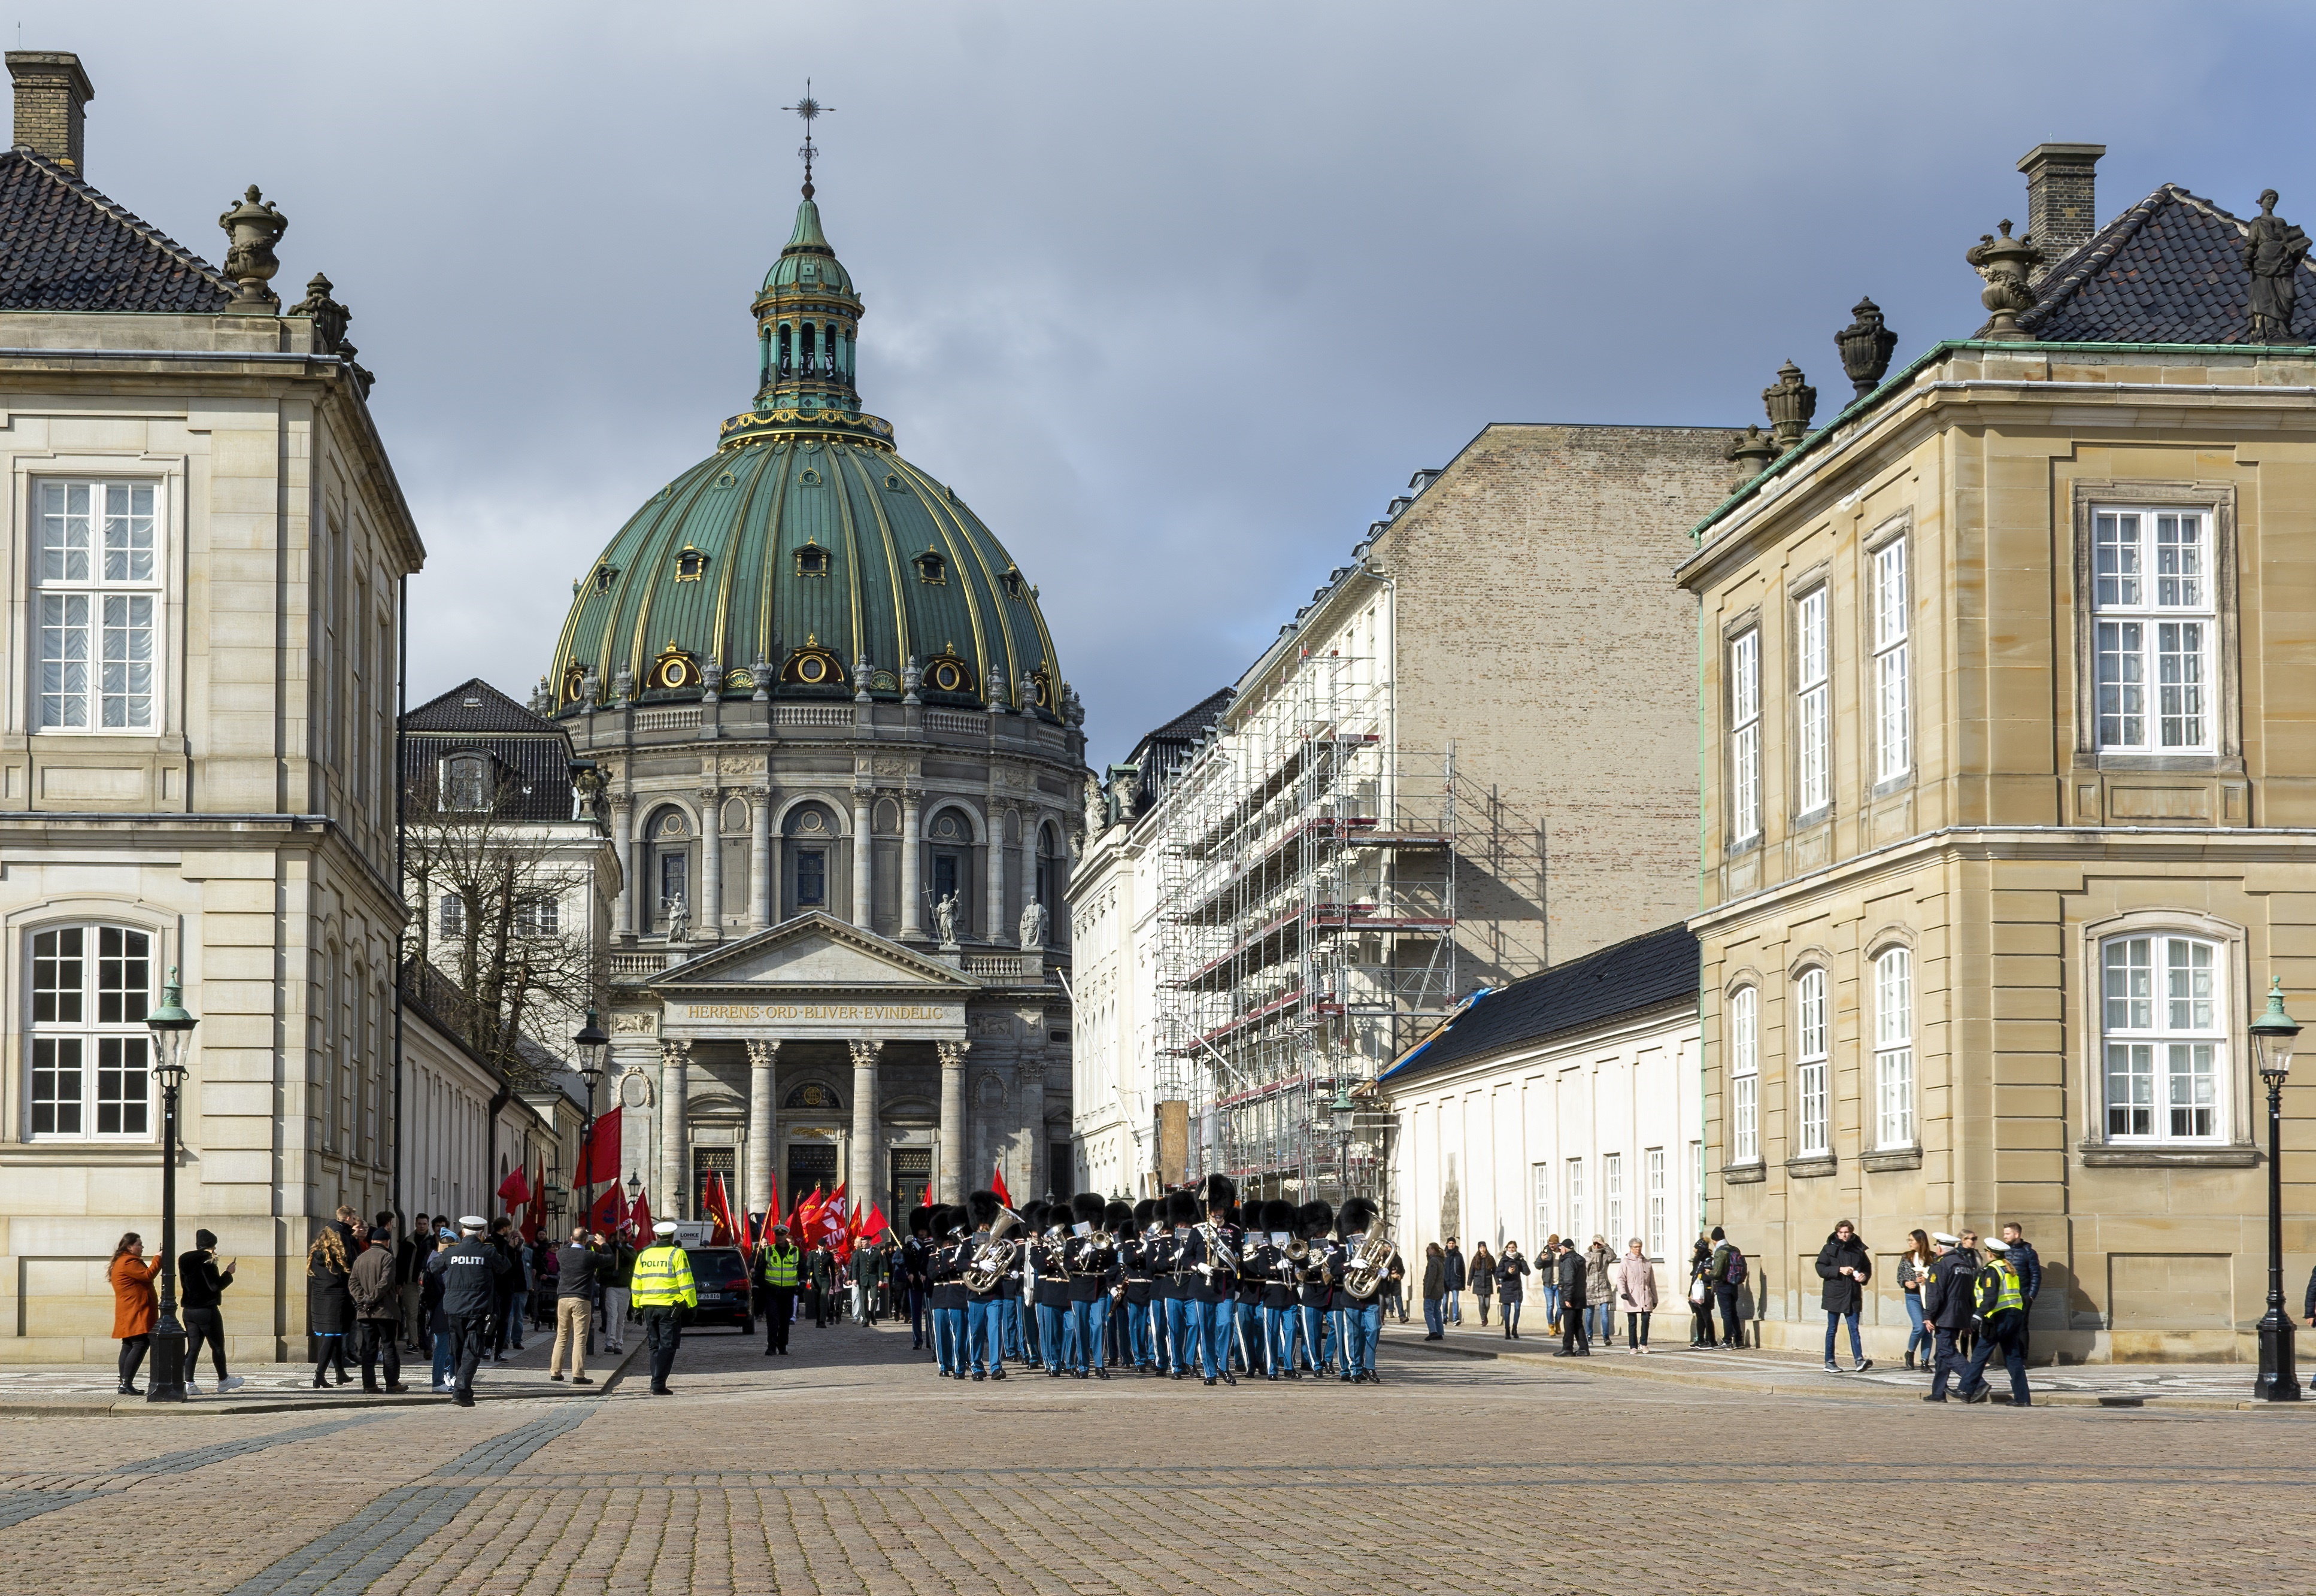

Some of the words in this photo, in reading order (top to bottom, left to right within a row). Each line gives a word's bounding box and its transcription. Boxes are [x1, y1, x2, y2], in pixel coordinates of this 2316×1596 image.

[689, 1006, 759, 1018] HERRENS
[765, 1006, 798, 1018] ORD
[804, 1006, 859, 1019] BLIVER
[864, 1007, 943, 1019] EVINDELIG
[451, 1256, 484, 1265] POLITI
